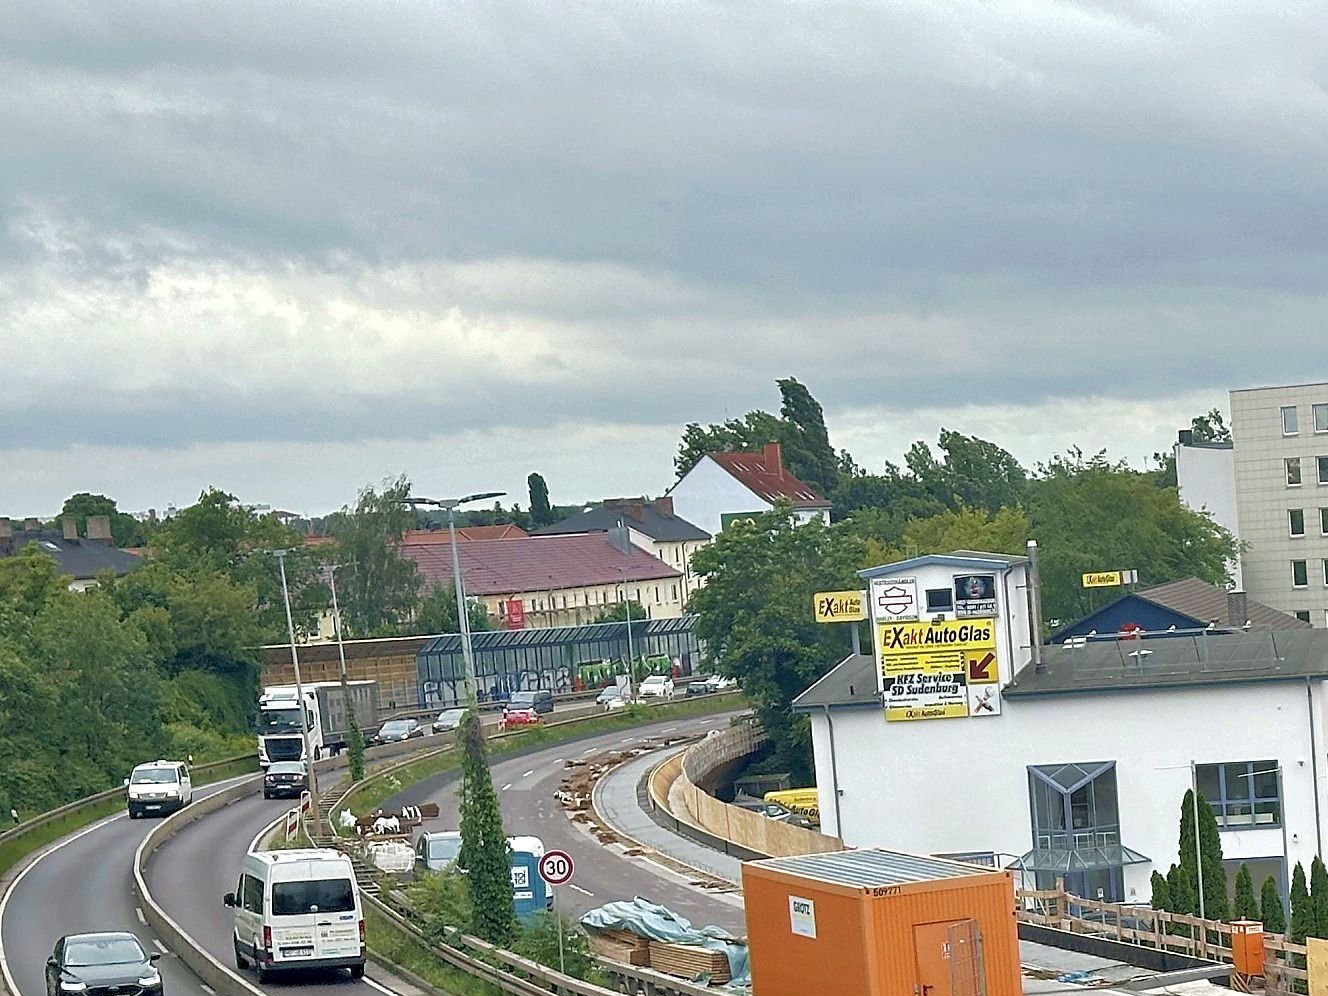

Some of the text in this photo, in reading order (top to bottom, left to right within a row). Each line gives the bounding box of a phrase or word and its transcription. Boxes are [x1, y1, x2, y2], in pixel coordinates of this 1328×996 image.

[897, 671, 952, 684] KFZ Service
[892, 682, 959, 696] SD Sudenburg
[546, 860, 566, 875] 30
